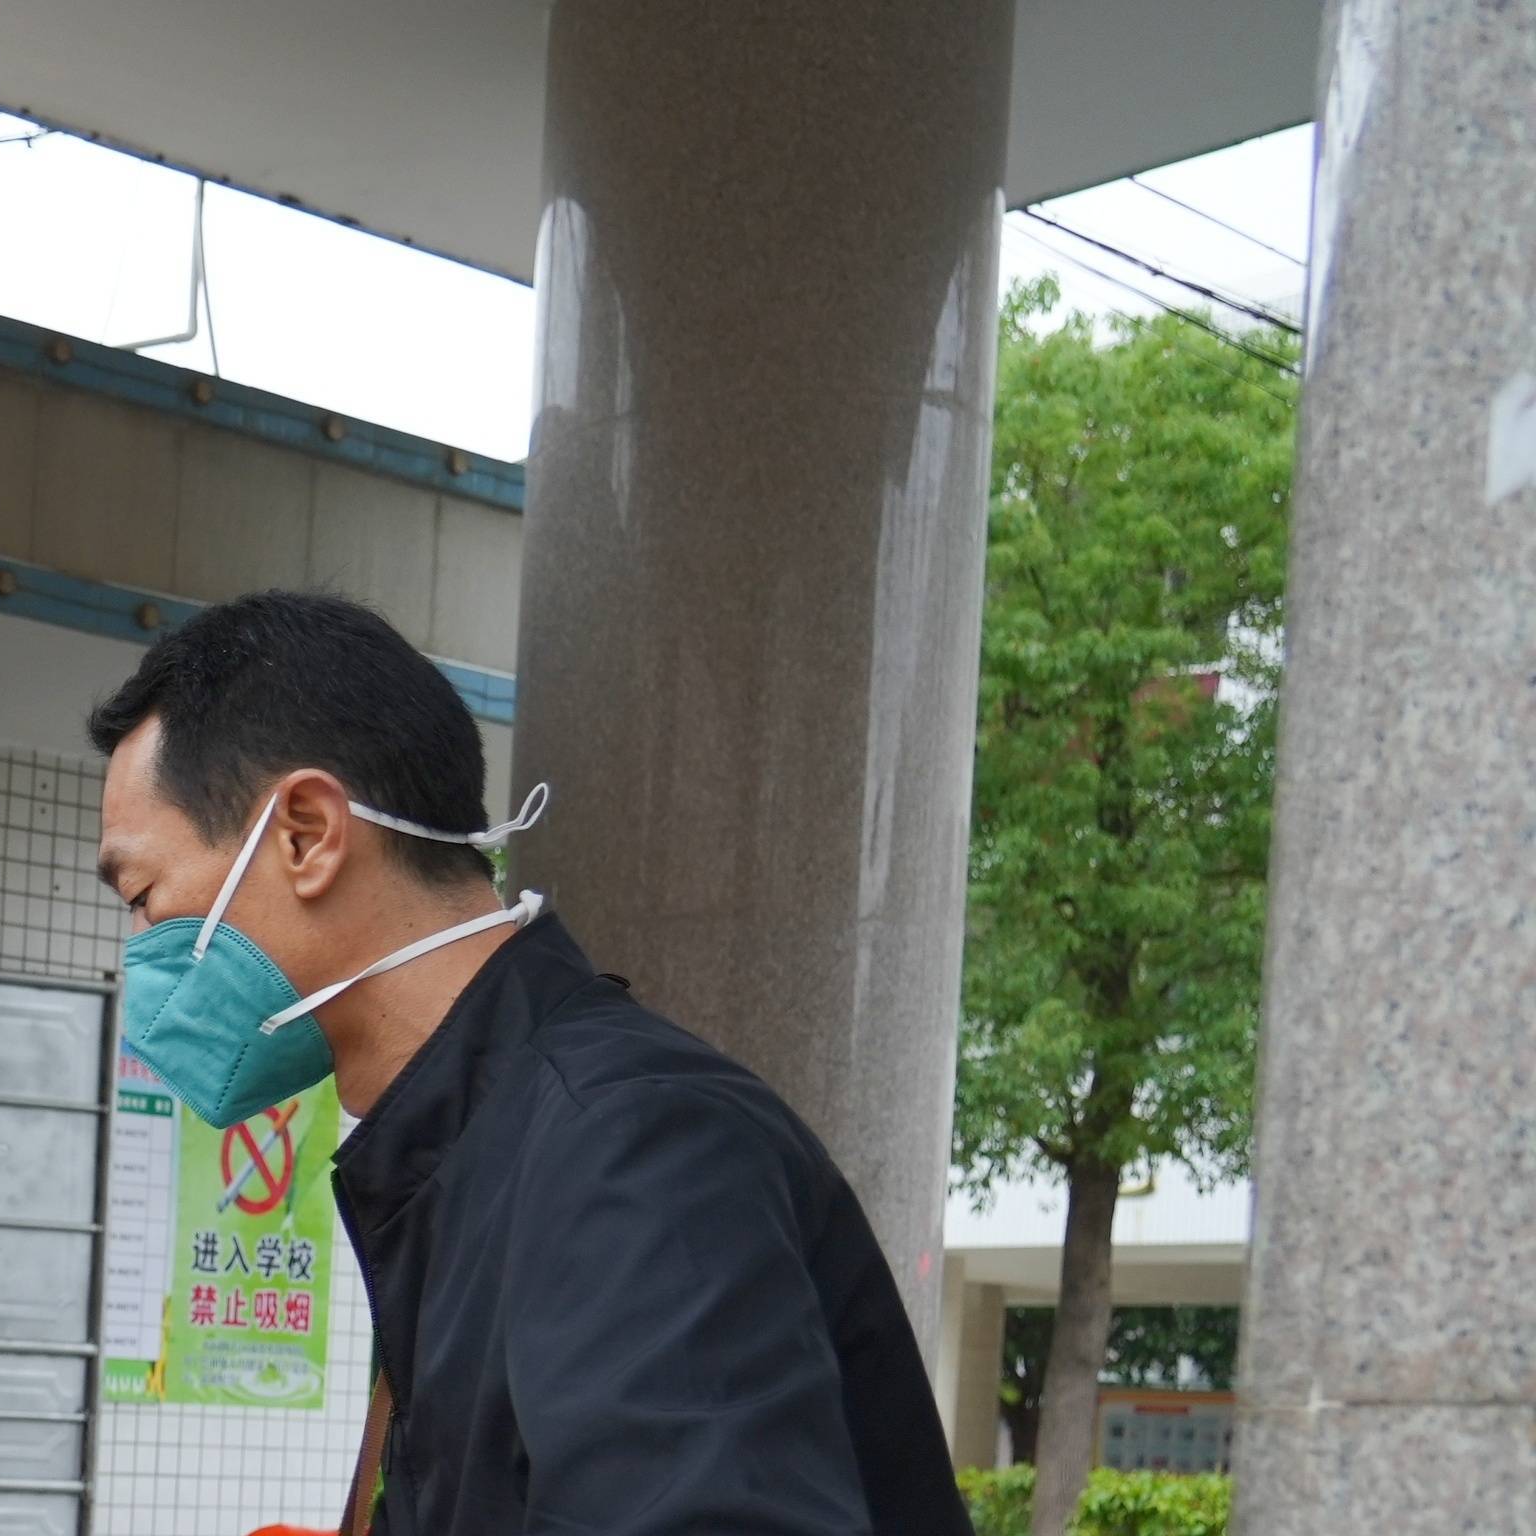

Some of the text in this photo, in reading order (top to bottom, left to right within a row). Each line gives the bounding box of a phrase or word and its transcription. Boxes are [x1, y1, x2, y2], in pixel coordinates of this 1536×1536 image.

[193, 1231, 313, 1281] 进入学校
[191, 1284, 311, 1333] 禁止吸烟
